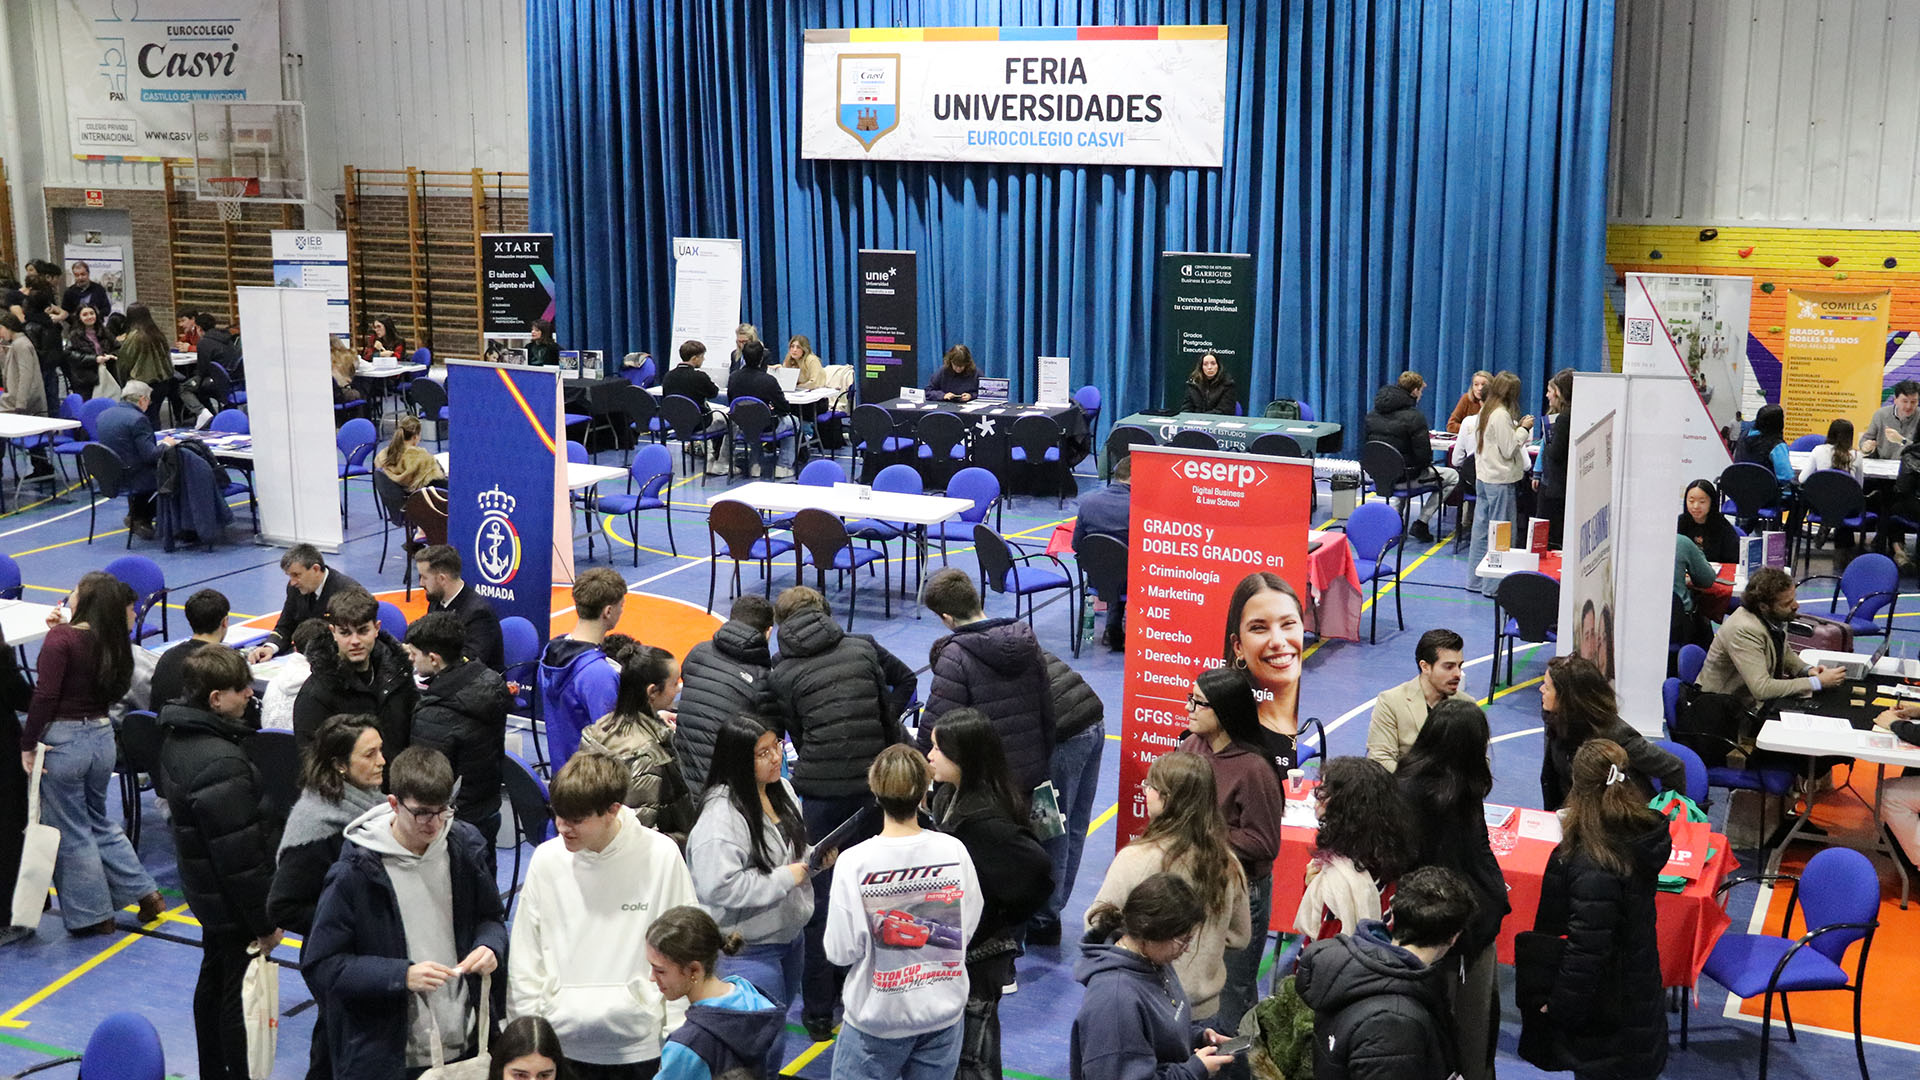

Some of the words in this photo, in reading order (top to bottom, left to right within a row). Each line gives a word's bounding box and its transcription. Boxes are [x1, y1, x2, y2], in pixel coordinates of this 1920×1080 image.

[167, 25, 234, 36] EUROCOLEGIO
[138, 43, 239, 78] Casvi
[1005, 57, 1087, 85] FERIA
[110, 92, 125, 101] PAX
[143, 93, 179, 101] CASTILLO
[180, 93, 191, 101] DE
[193, 93, 245, 101] VILLAVICIOSA
[934, 94, 1162, 123] UNIVERSIDADES
[81, 131, 134, 142] INTERNACIONAL
[968, 131, 1073, 146] EUROCOLEGIO
[1077, 132, 1124, 147] CASVI
[308, 236, 322, 246] IEB
[494, 242, 540, 252] XTART
[679, 246, 699, 256] UAX
[489, 281, 518, 290] siguiente
[519, 281, 535, 289] nivel
[1821, 301, 1877, 311] COMILLAS
[1218, 430, 1247, 438] ESTUDIOS
[1184, 460, 1255, 488] eserp
[1192, 486, 1213, 495] Digital
[1215, 488, 1244, 498] Business
[1196, 496, 1201, 504] &
[1203, 497, 1216, 505] Law
[1217, 498, 1240, 507] School
[1143, 519, 1202, 538] GRADOS
[1206, 528, 1214, 542] y
[1143, 538, 1198, 557] DOBLES
[1202, 545, 1262, 565] GRADOS
[1266, 555, 1284, 567] en
[1149, 564, 1220, 584] Criminología
[475, 584, 515, 601] ARMADA
[1148, 585, 1204, 605] Marketing
[1147, 606, 1170, 620] ADE
[1146, 627, 1192, 644] Derecho
[1145, 649, 1190, 665] Derecho
[1144, 671, 1190, 688] Derecho
[1134, 707, 1173, 726] CFGS
[621, 902, 648, 911] cold
[904, 964, 922, 976] CUP
[900, 976, 913, 985] AND
[916, 970, 962, 980] TIEBREAKER
